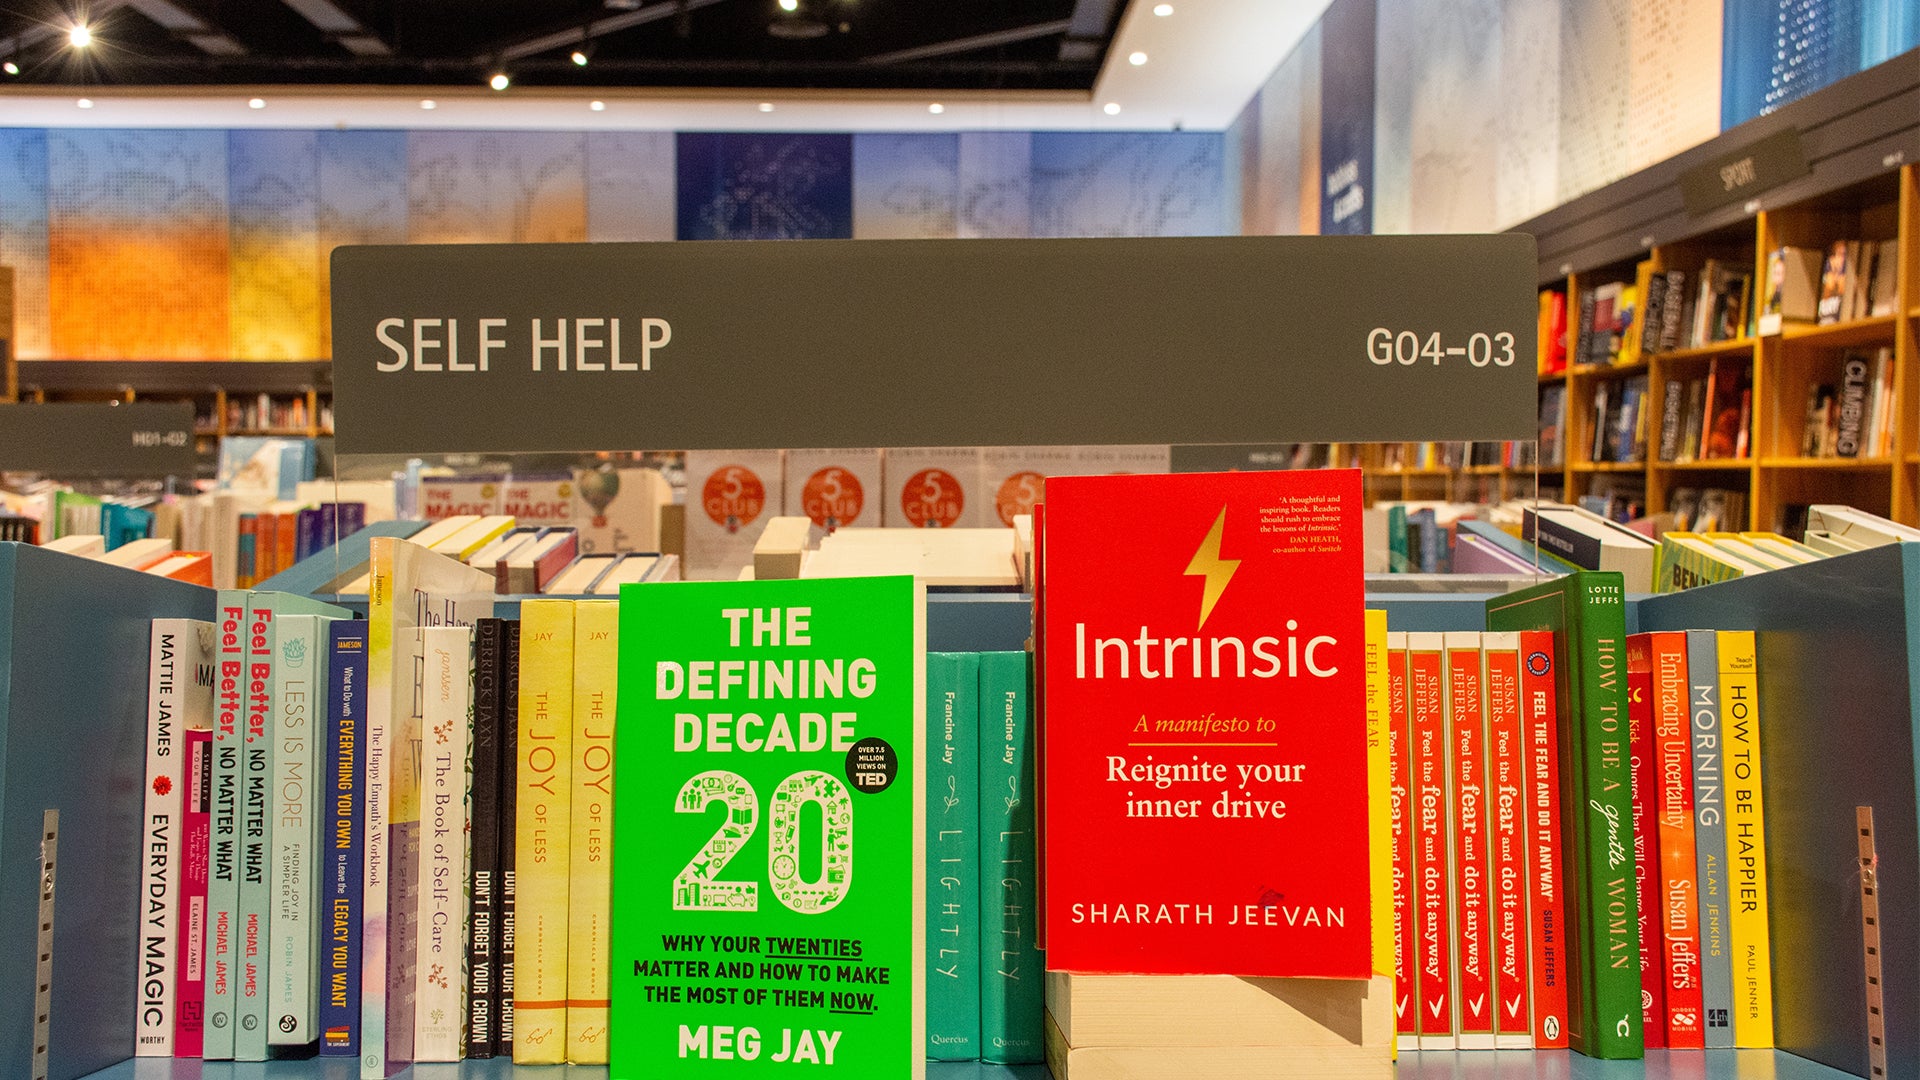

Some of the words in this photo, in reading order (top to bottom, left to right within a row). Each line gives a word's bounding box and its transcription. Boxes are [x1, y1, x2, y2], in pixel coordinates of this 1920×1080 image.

[1719, 156, 1757, 191] SPORT
[375, 317, 507, 372] SELF
[531, 318, 672, 371] HELP
[1366, 327, 1515, 368] G04-03
[1837, 360, 1867, 457] CLIMBING
[922, 471, 943, 502] 5
[1289, 495, 1326, 504] thoughtful
[505, 502, 570, 518] MAGIC
[906, 502, 958, 519] CLUB
[1260, 507, 1290, 515] inspiring
[1312, 514, 1341, 522] embrace
[1310, 535, 1341, 543] HEATH,
[1588, 586, 1619, 594] LOTTE
[1589, 596, 1619, 604] JEFFS
[534, 633, 553, 641] JAY
[722, 607, 811, 647] THE
[337, 641, 362, 649] JAMESON
[1075, 619, 1338, 678] Intrinsic
[159, 634, 175, 694] MATTIE
[343, 666, 353, 684] What
[436, 649, 456, 702] janssen
[655, 658, 877, 700] DEFINING
[1598, 639, 1617, 693] HOW
[284, 681, 305, 728] LESS
[342, 701, 352, 717] with
[343, 692, 353, 701] Do
[536, 692, 547, 720] THE
[1490, 668, 1504, 722] JEFFERS
[1504, 676, 1515, 714] SUSAN
[1657, 652, 1684, 737] Embracing
[157, 700, 173, 757] JAMES
[945, 692, 955, 741] Francine
[1133, 714, 1149, 732] A
[1155, 713, 1249, 736] manifesto
[1256, 715, 1276, 732] to
[1600, 702, 1619, 732] TO
[1730, 686, 1749, 744] HOW
[284, 737, 303, 754] IS
[674, 712, 857, 752] DECADE
[1498, 730, 1509, 757] Feel
[338, 720, 355, 790] EVERYTHING
[436, 752, 451, 786] The
[528, 729, 556, 795] JOY
[942, 744, 955, 764] Jay
[1499, 759, 1510, 782] the
[1601, 742, 1620, 768] BE
[1694, 685, 1720, 827] MORNING
[1734, 749, 1751, 780] TO
[202, 753, 210, 801] SIMPLIFY
[855, 773, 887, 786] TED
[1106, 755, 1227, 789] Reignite
[1236, 763, 1306, 789] your
[1603, 778, 1621, 792] A
[1662, 741, 1688, 829] Uncertainty
[282, 763, 303, 828] MORE
[336, 795, 352, 814] YOU
[1126, 791, 1201, 818] inner
[1211, 790, 1287, 819] drive
[1498, 784, 1517, 835] fear
[1736, 790, 1752, 813] BE
[434, 793, 449, 838] Book
[535, 804, 547, 824] OF
[336, 816, 352, 849] OWN
[534, 830, 547, 863] LESS
[672, 770, 853, 914] 20
[1589, 799, 1626, 870] gentle
[291, 844, 300, 886] FINDING
[434, 843, 449, 862] of
[1501, 837, 1513, 862] and
[147, 814, 169, 928] EVERYDAY
[282, 855, 290, 897] SIMPLER
[337, 862, 346, 881] Leave
[1502, 867, 1516, 891] do
[1706, 854, 1717, 896] ALLAN
[1737, 823, 1758, 913] HAPPIER
[291, 889, 299, 910] JOY
[337, 882, 346, 894] the
[474, 871, 491, 906] DON'T
[936, 829, 963, 978] LIGHTLY
[1502, 894, 1517, 908] it
[1668, 879, 1691, 930] Susan
[281, 900, 289, 920] LIFE
[291, 912, 298, 921] IN
[334, 899, 349, 942] LEGACY
[432, 867, 449, 953] Self-Care
[1071, 903, 1213, 924] SHARATH
[1228, 904, 1345, 927] JEEVAN
[1607, 878, 1630, 969] WOMAN
[190, 934, 198, 946] ST.
[473, 912, 490, 956] FORGET
[662, 934, 706, 952] WHY
[710, 936, 761, 953] YOUR
[765, 937, 863, 957] TWENTIES
[1706, 903, 1721, 957] JENKINS
[332, 945, 348, 969] YOU
[633, 960, 710, 978] MATTER
[715, 962, 754, 979] AND
[759, 963, 803, 980] HOW
[808, 965, 831, 982] TO
[836, 966, 890, 984] MAKE
[1665, 933, 1697, 989] Jeffers
[1747, 945, 1756, 973] PAUL
[143, 936, 166, 1027] MAGIC
[331, 973, 348, 1008] WANT
[473, 962, 489, 993] YOUR
[644, 985, 681, 1003] THE
[687, 987, 738, 1005] MOST
[743, 989, 767, 1006] OF
[772, 990, 825, 1008] THEM
[829, 992, 878, 1011] NOW.
[1746, 976, 1758, 1019] JENNER
[472, 999, 488, 1043] CROWN
[140, 1036, 165, 1044] WORTHY
[678, 1024, 761, 1061] MEG
[771, 1028, 842, 1065] JAY
[930, 1034, 968, 1045] Quercus
